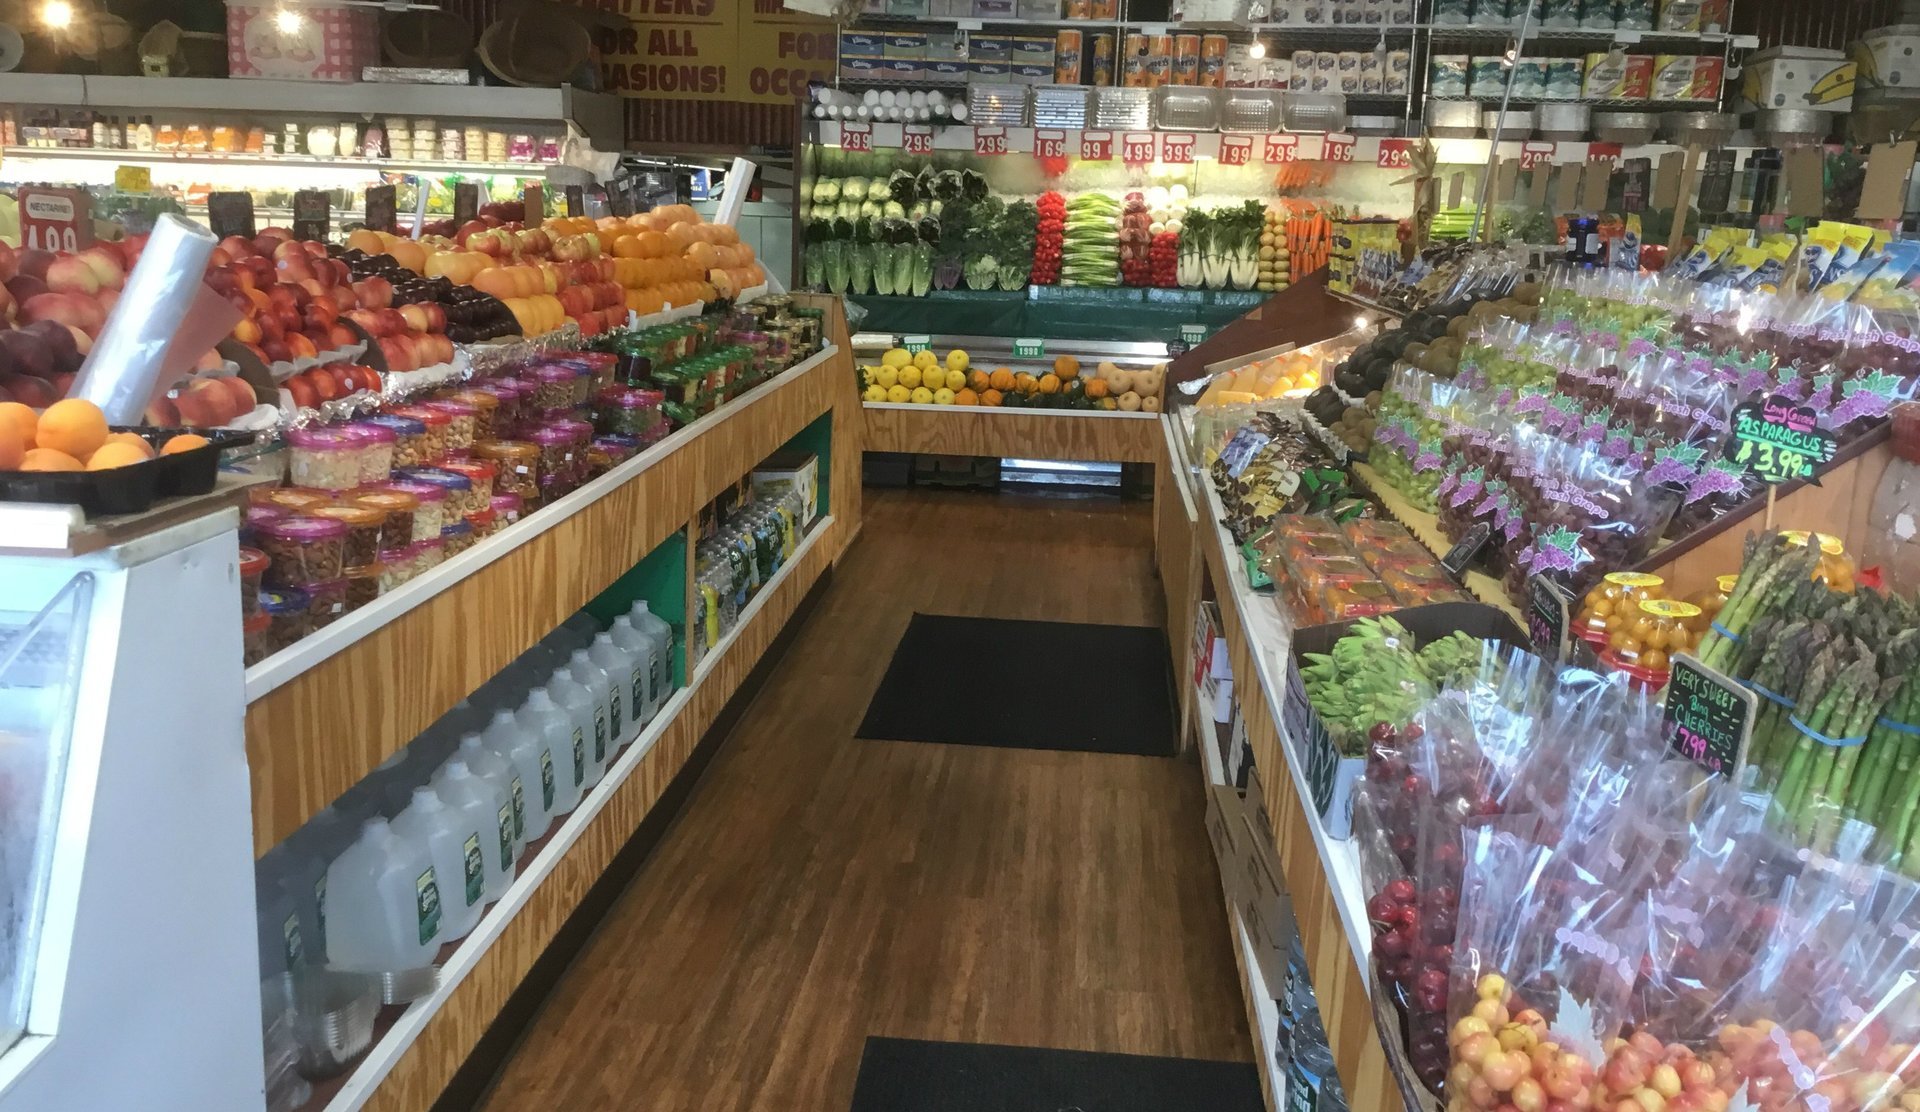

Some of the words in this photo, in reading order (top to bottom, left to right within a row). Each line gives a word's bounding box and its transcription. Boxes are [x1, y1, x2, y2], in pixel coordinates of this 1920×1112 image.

[648, 29, 698, 57] ALL
[843, 132, 870, 150] 299
[905, 134, 932, 152] 299
[977, 136, 1005, 153] 299
[1036, 140, 1063, 156] 169
[1083, 142, 1101, 158] 99
[1124, 144, 1153, 161] 499
[1164, 144, 1192, 162] 399
[1222, 146, 1250, 164] 199
[1266, 145, 1294, 162] 299
[1325, 143, 1351, 161] 199
[1763, 397, 1788, 423] Long
[1737, 416, 1822, 452] ASPARAGUS
[1570, 493, 1610, 520] Grape
[1674, 666, 1700, 695] VERY
[1699, 678, 1739, 712] SWEET
[1674, 704, 1734, 751] CHERRIES
